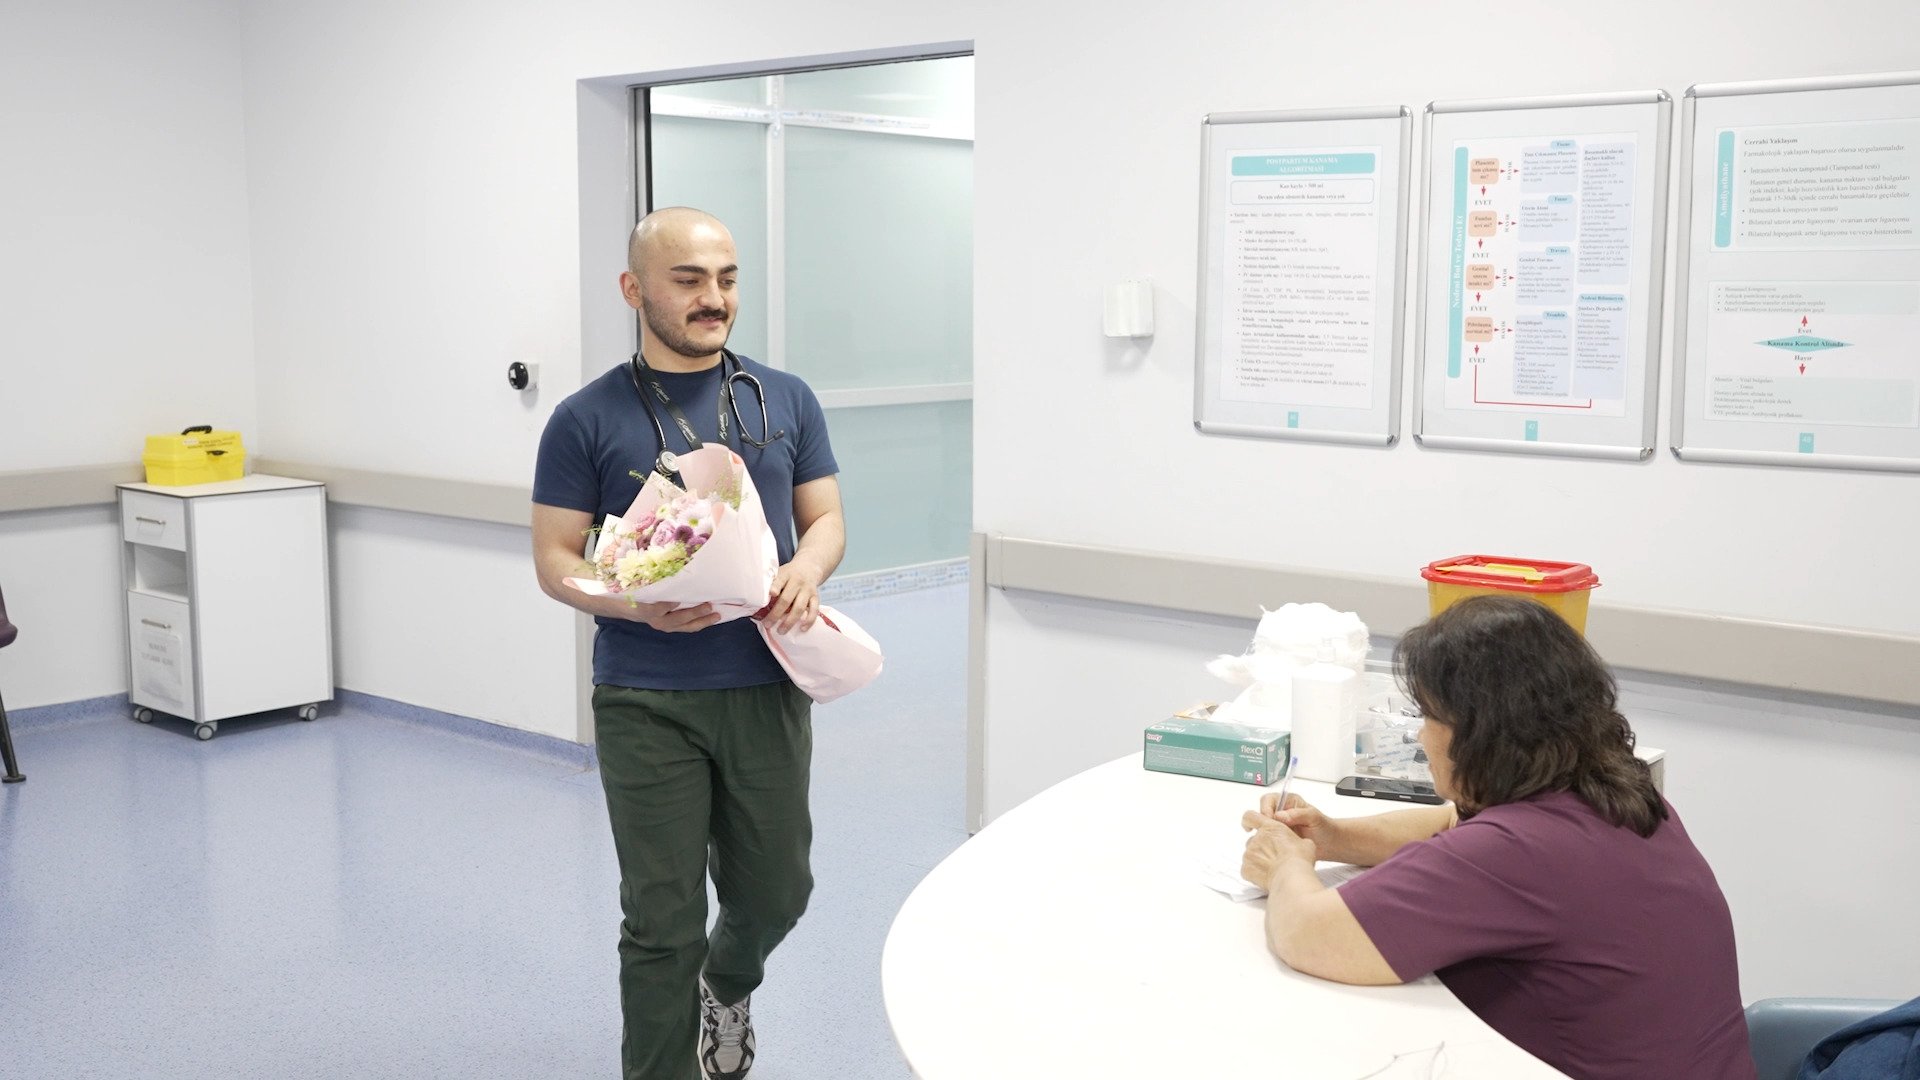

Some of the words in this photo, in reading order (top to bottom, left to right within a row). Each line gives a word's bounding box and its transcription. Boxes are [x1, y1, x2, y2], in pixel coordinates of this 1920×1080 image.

[1743, 149, 1781, 157] Farmakolojik
[1783, 149, 1810, 157] yaklaşım
[1798, 165, 1829, 173] tamponad
[1256, 773, 1262, 781] S
